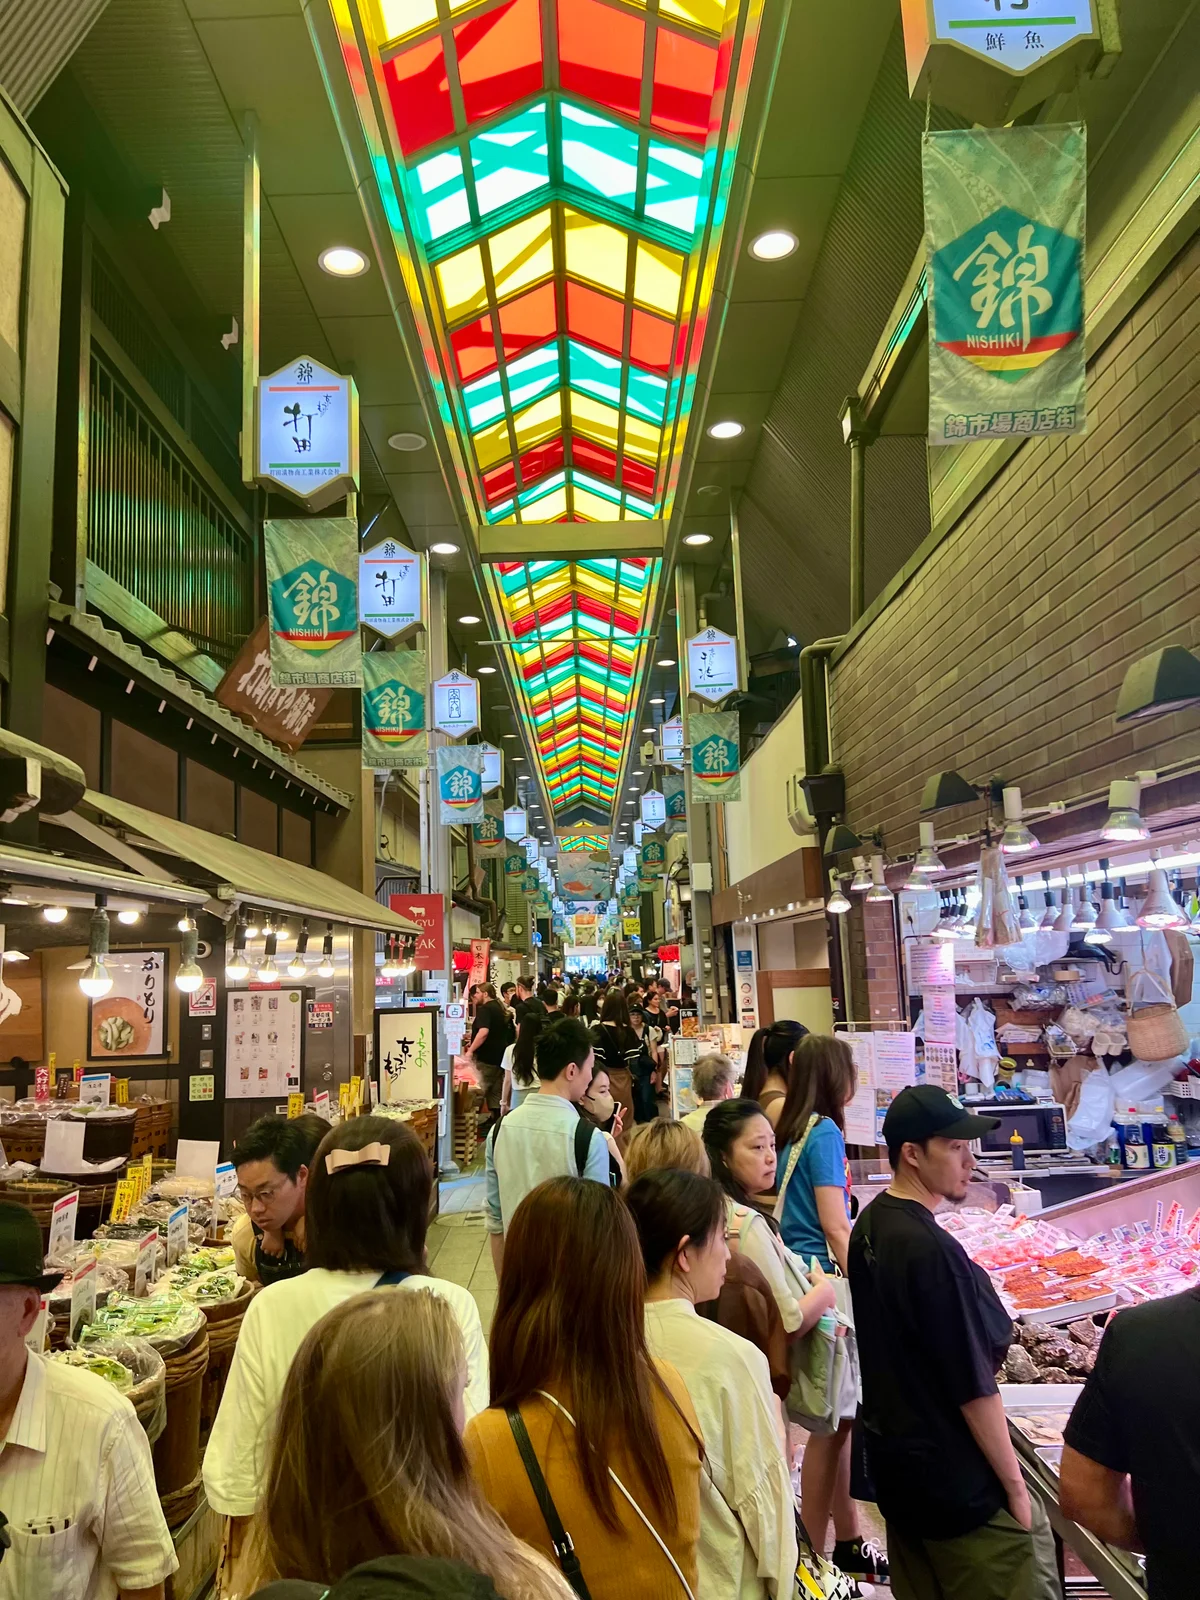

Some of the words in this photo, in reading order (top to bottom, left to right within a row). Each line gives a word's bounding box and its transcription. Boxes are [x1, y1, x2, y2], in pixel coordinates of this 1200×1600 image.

[986, 31, 1044, 50] 鮮魚
[953, 224, 1053, 352] 錦
[966, 332, 1020, 349] NISHIKI
[294, 363, 312, 384] 錦
[944, 406, 1077, 438] 錦市場商店街
[282, 569, 340, 640] 錦
[289, 628, 322, 637] NISHIKI
[279, 671, 356, 685] 錦市場商店街
[372, 686, 412, 735] 錦
[698, 739, 729, 777] 錦
[445, 769, 474, 803] 錦
[477, 817, 498, 842] 錦
[645, 843, 660, 862] 錦
[508, 857, 522, 874] 錦
